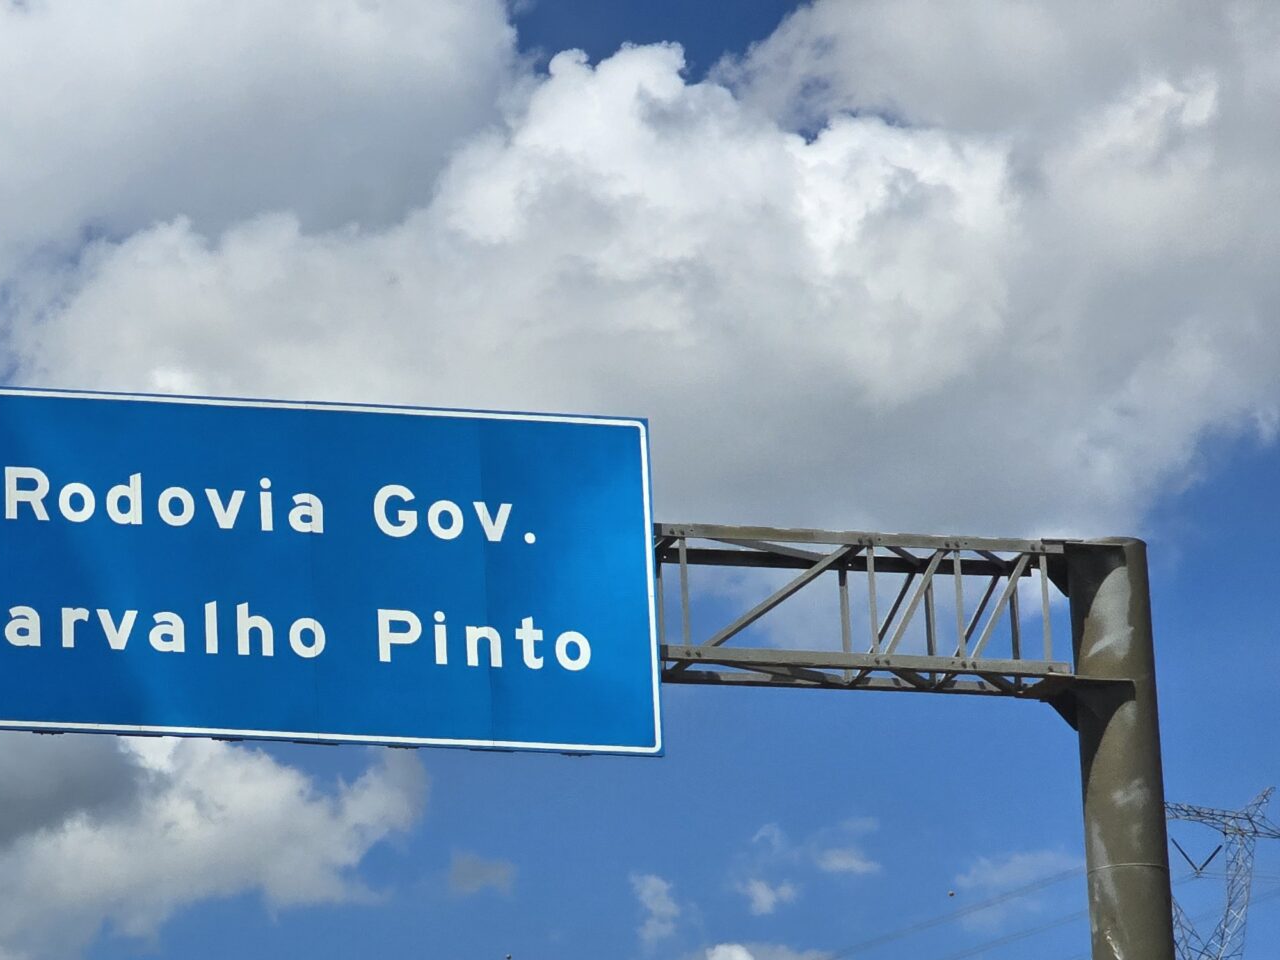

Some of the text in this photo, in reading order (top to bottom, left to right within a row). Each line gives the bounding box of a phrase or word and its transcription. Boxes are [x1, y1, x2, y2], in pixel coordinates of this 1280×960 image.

[4, 465, 538, 545] Rodovia Gov.
[377, 608, 592, 672] Pinto
